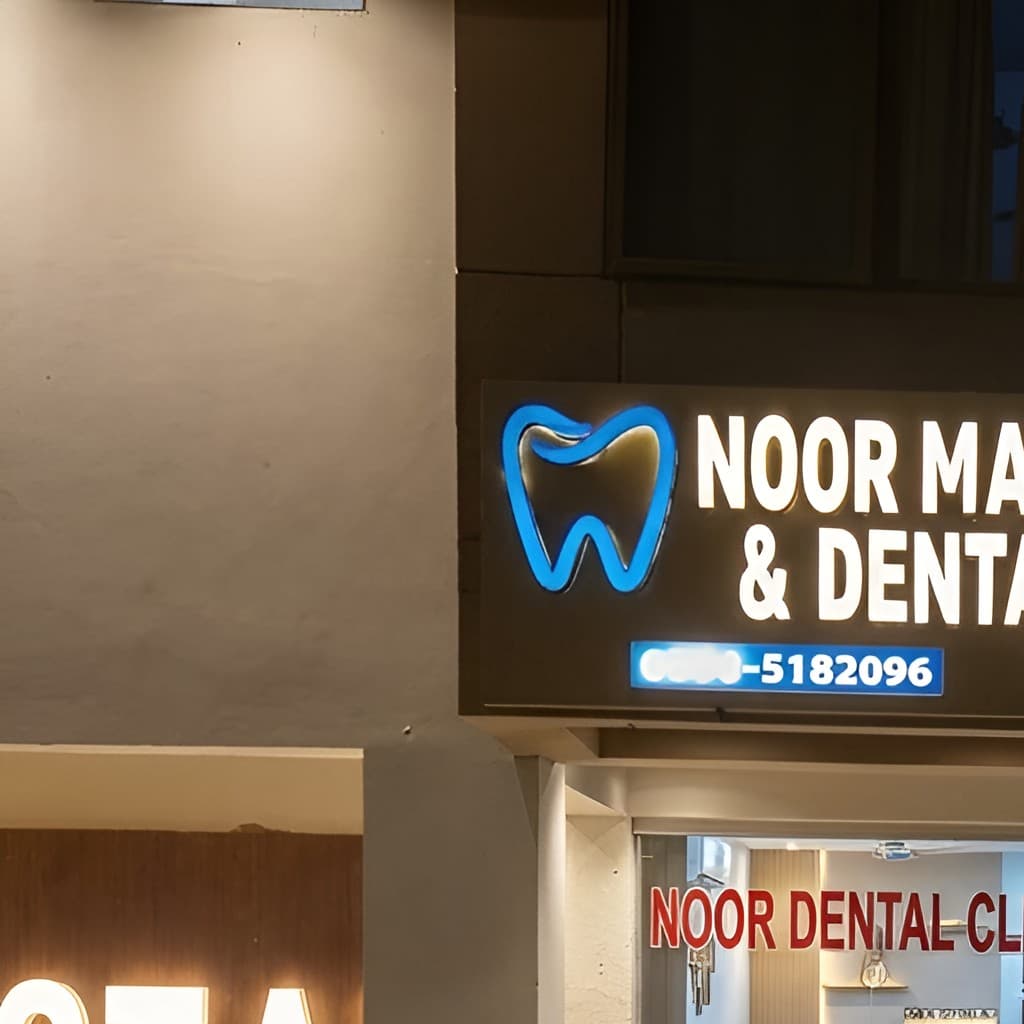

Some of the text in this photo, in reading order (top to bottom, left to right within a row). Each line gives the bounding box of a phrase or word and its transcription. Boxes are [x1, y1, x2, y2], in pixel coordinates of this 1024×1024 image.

[697, 414, 900, 514] NOOR
[739, 523, 791, 621] &
[650, 886, 777, 949] NOOR
[789, 889, 955, 951] DENTAL
